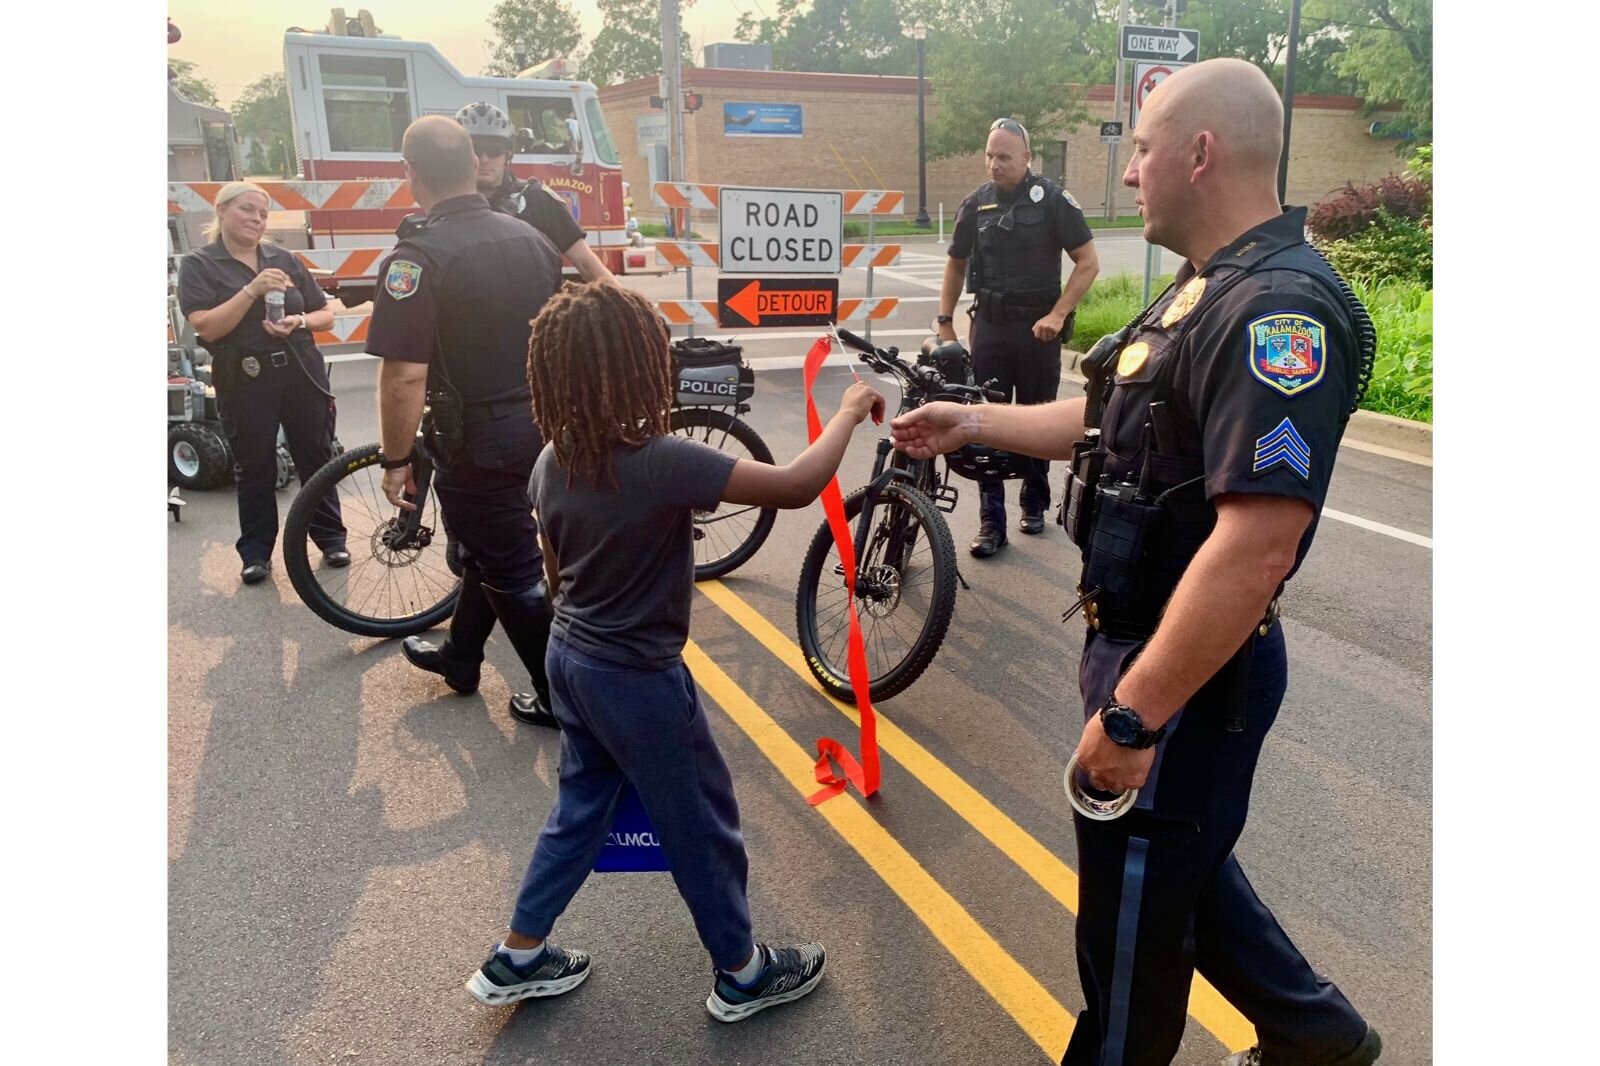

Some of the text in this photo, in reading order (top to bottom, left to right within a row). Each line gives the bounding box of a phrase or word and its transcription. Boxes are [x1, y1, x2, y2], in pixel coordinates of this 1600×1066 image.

[1131, 36, 1179, 52] ONE WAY
[746, 202, 818, 228] ROAD
[730, 236, 833, 262] CLOSED
[757, 293, 827, 312] DETOUR
[1266, 324, 1313, 337] KALAMAZOO
[1274, 318, 1304, 327] CITY OF
[680, 380, 737, 395] POLICE
